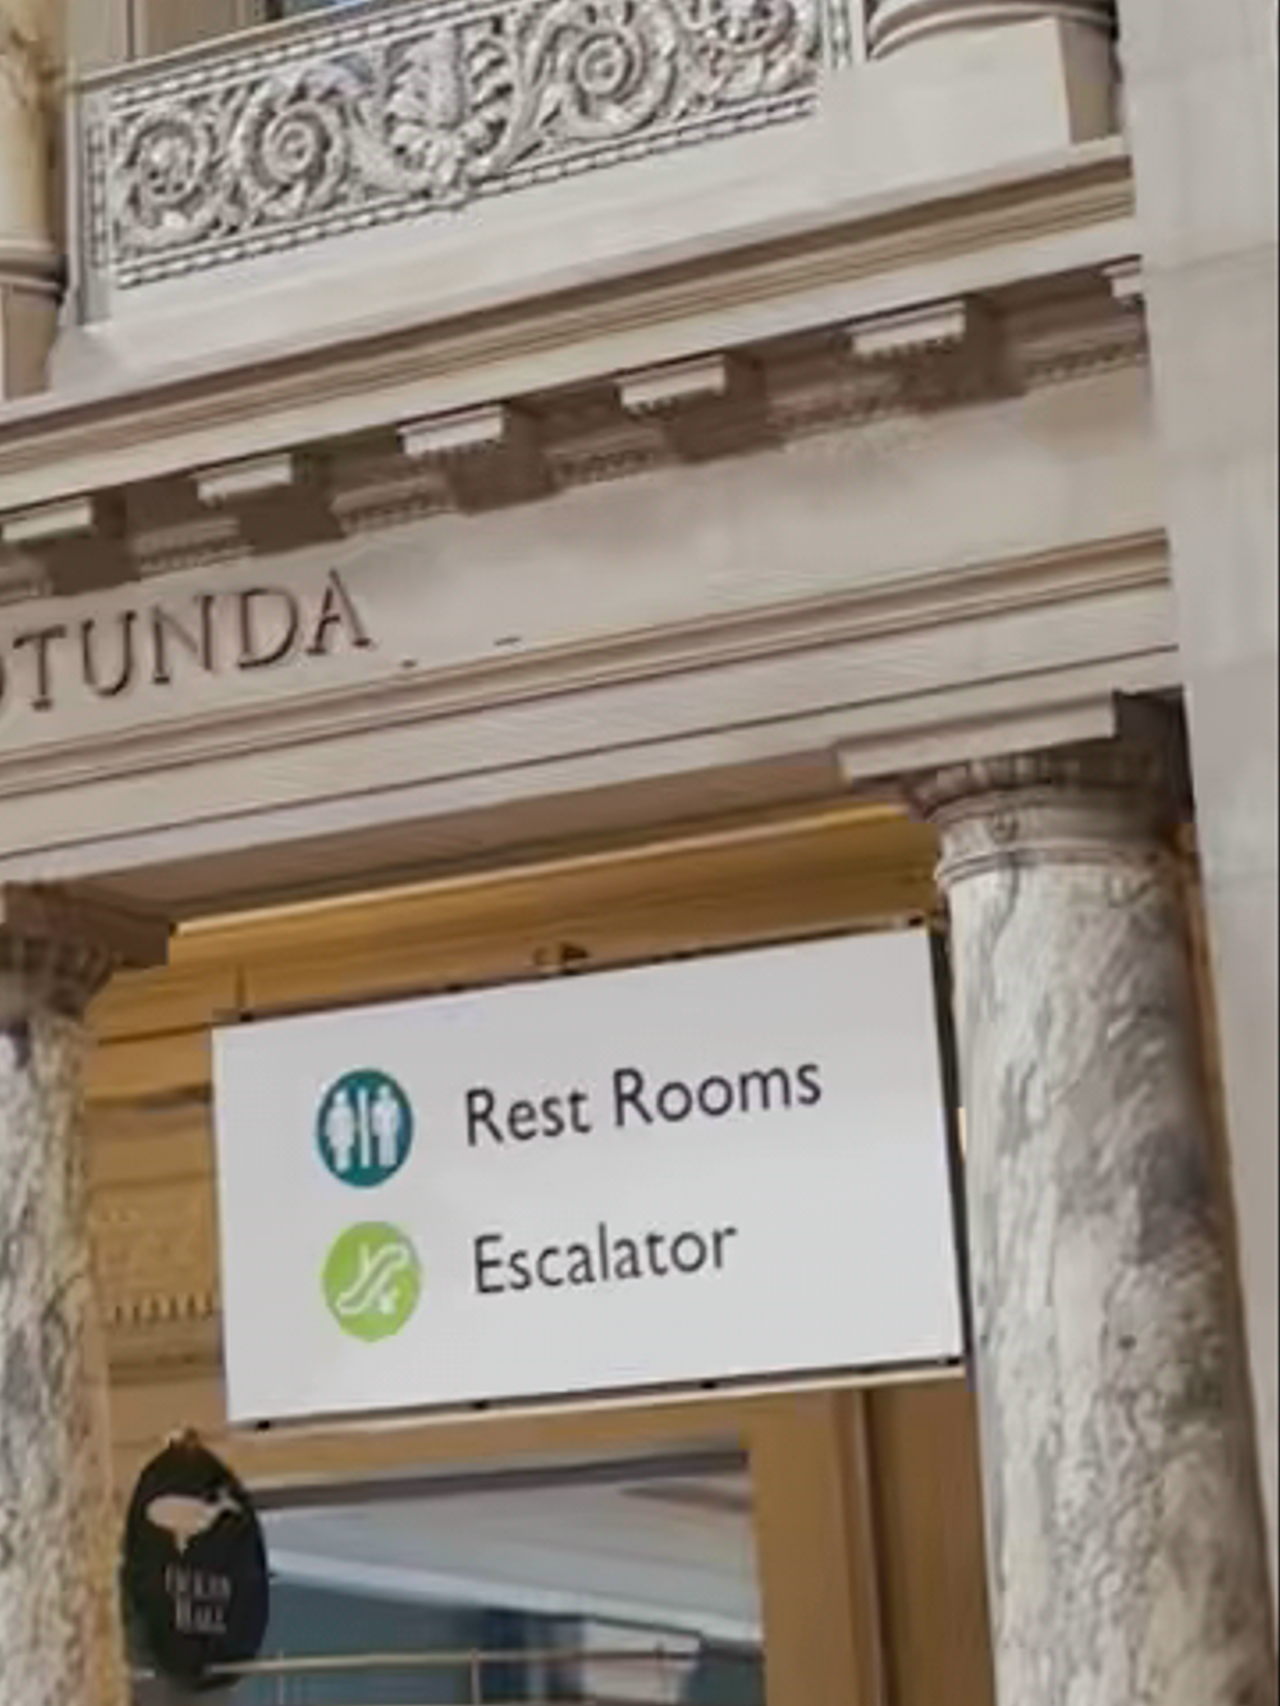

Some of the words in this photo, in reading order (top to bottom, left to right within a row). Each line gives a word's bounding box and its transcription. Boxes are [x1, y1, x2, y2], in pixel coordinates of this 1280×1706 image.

[464, 1088, 591, 1148] Rest
[612, 1060, 824, 1128] Rooms
[472, 1224, 738, 1296] Escalator
